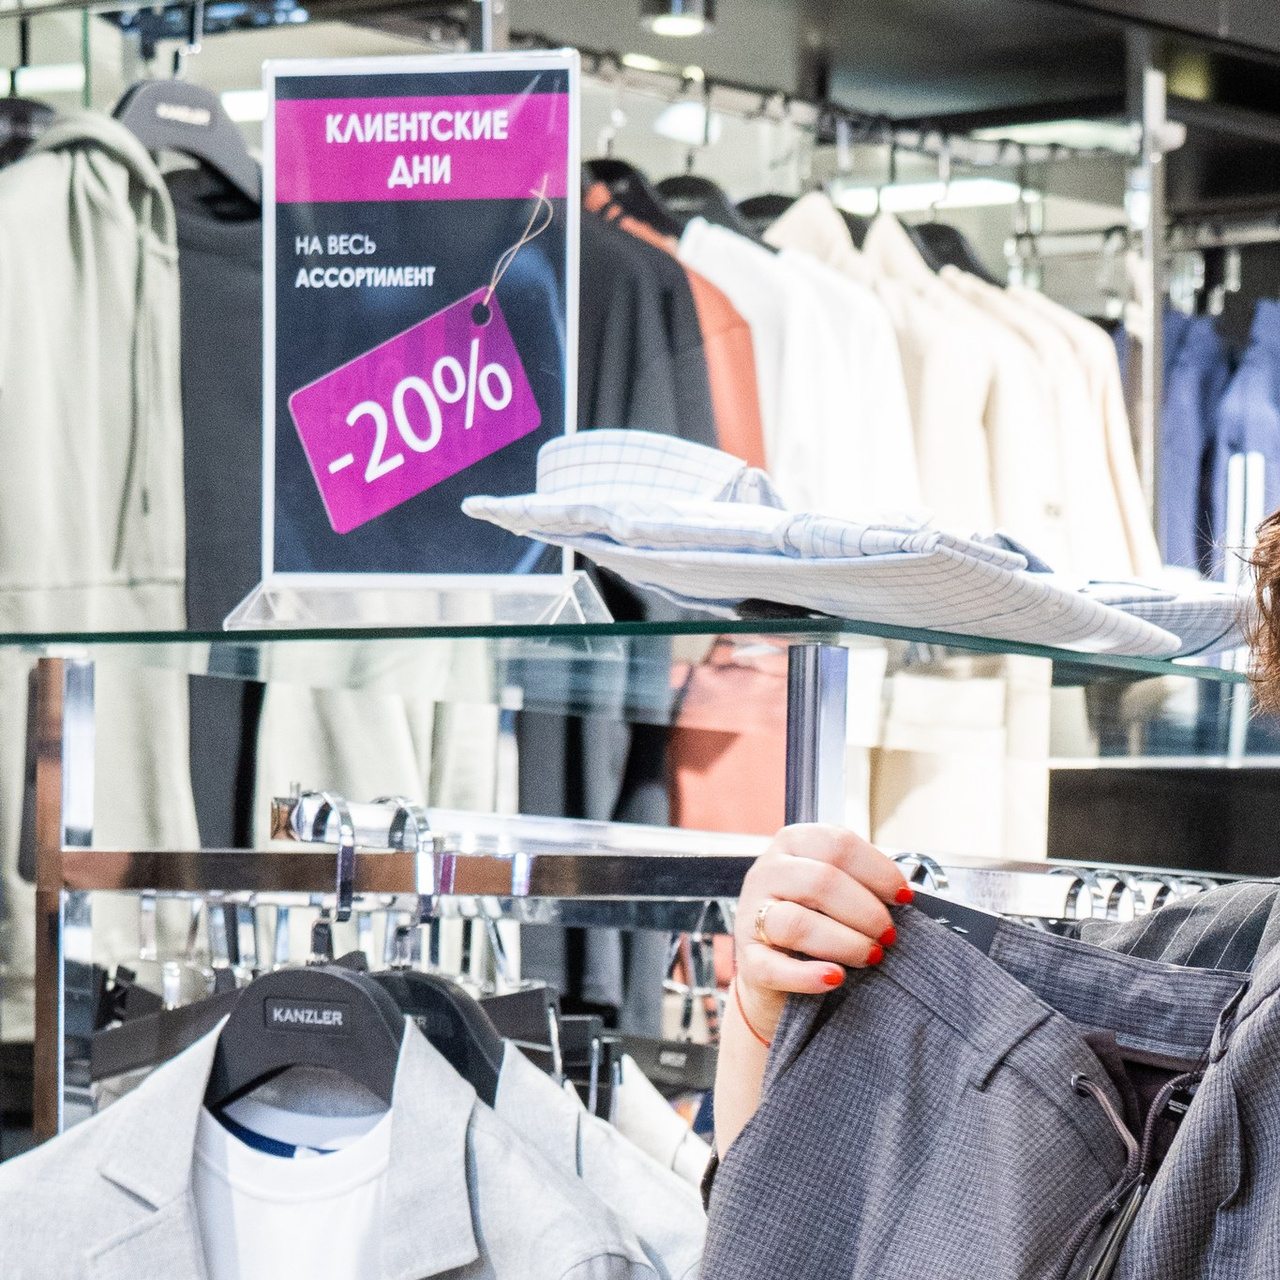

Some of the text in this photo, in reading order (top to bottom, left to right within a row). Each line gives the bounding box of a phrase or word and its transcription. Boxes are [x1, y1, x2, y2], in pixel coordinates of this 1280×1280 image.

[326, 110, 509, 144] КЛИЕНТСКИЕ
[387, 154, 452, 188] ДНИ
[295, 234, 377, 256] НА ВЕСЬ
[295, 265, 436, 289] АССОРТИМЕНТ
[327, 337, 514, 484] -20%
[273, 1006, 343, 1027] KANZLER
